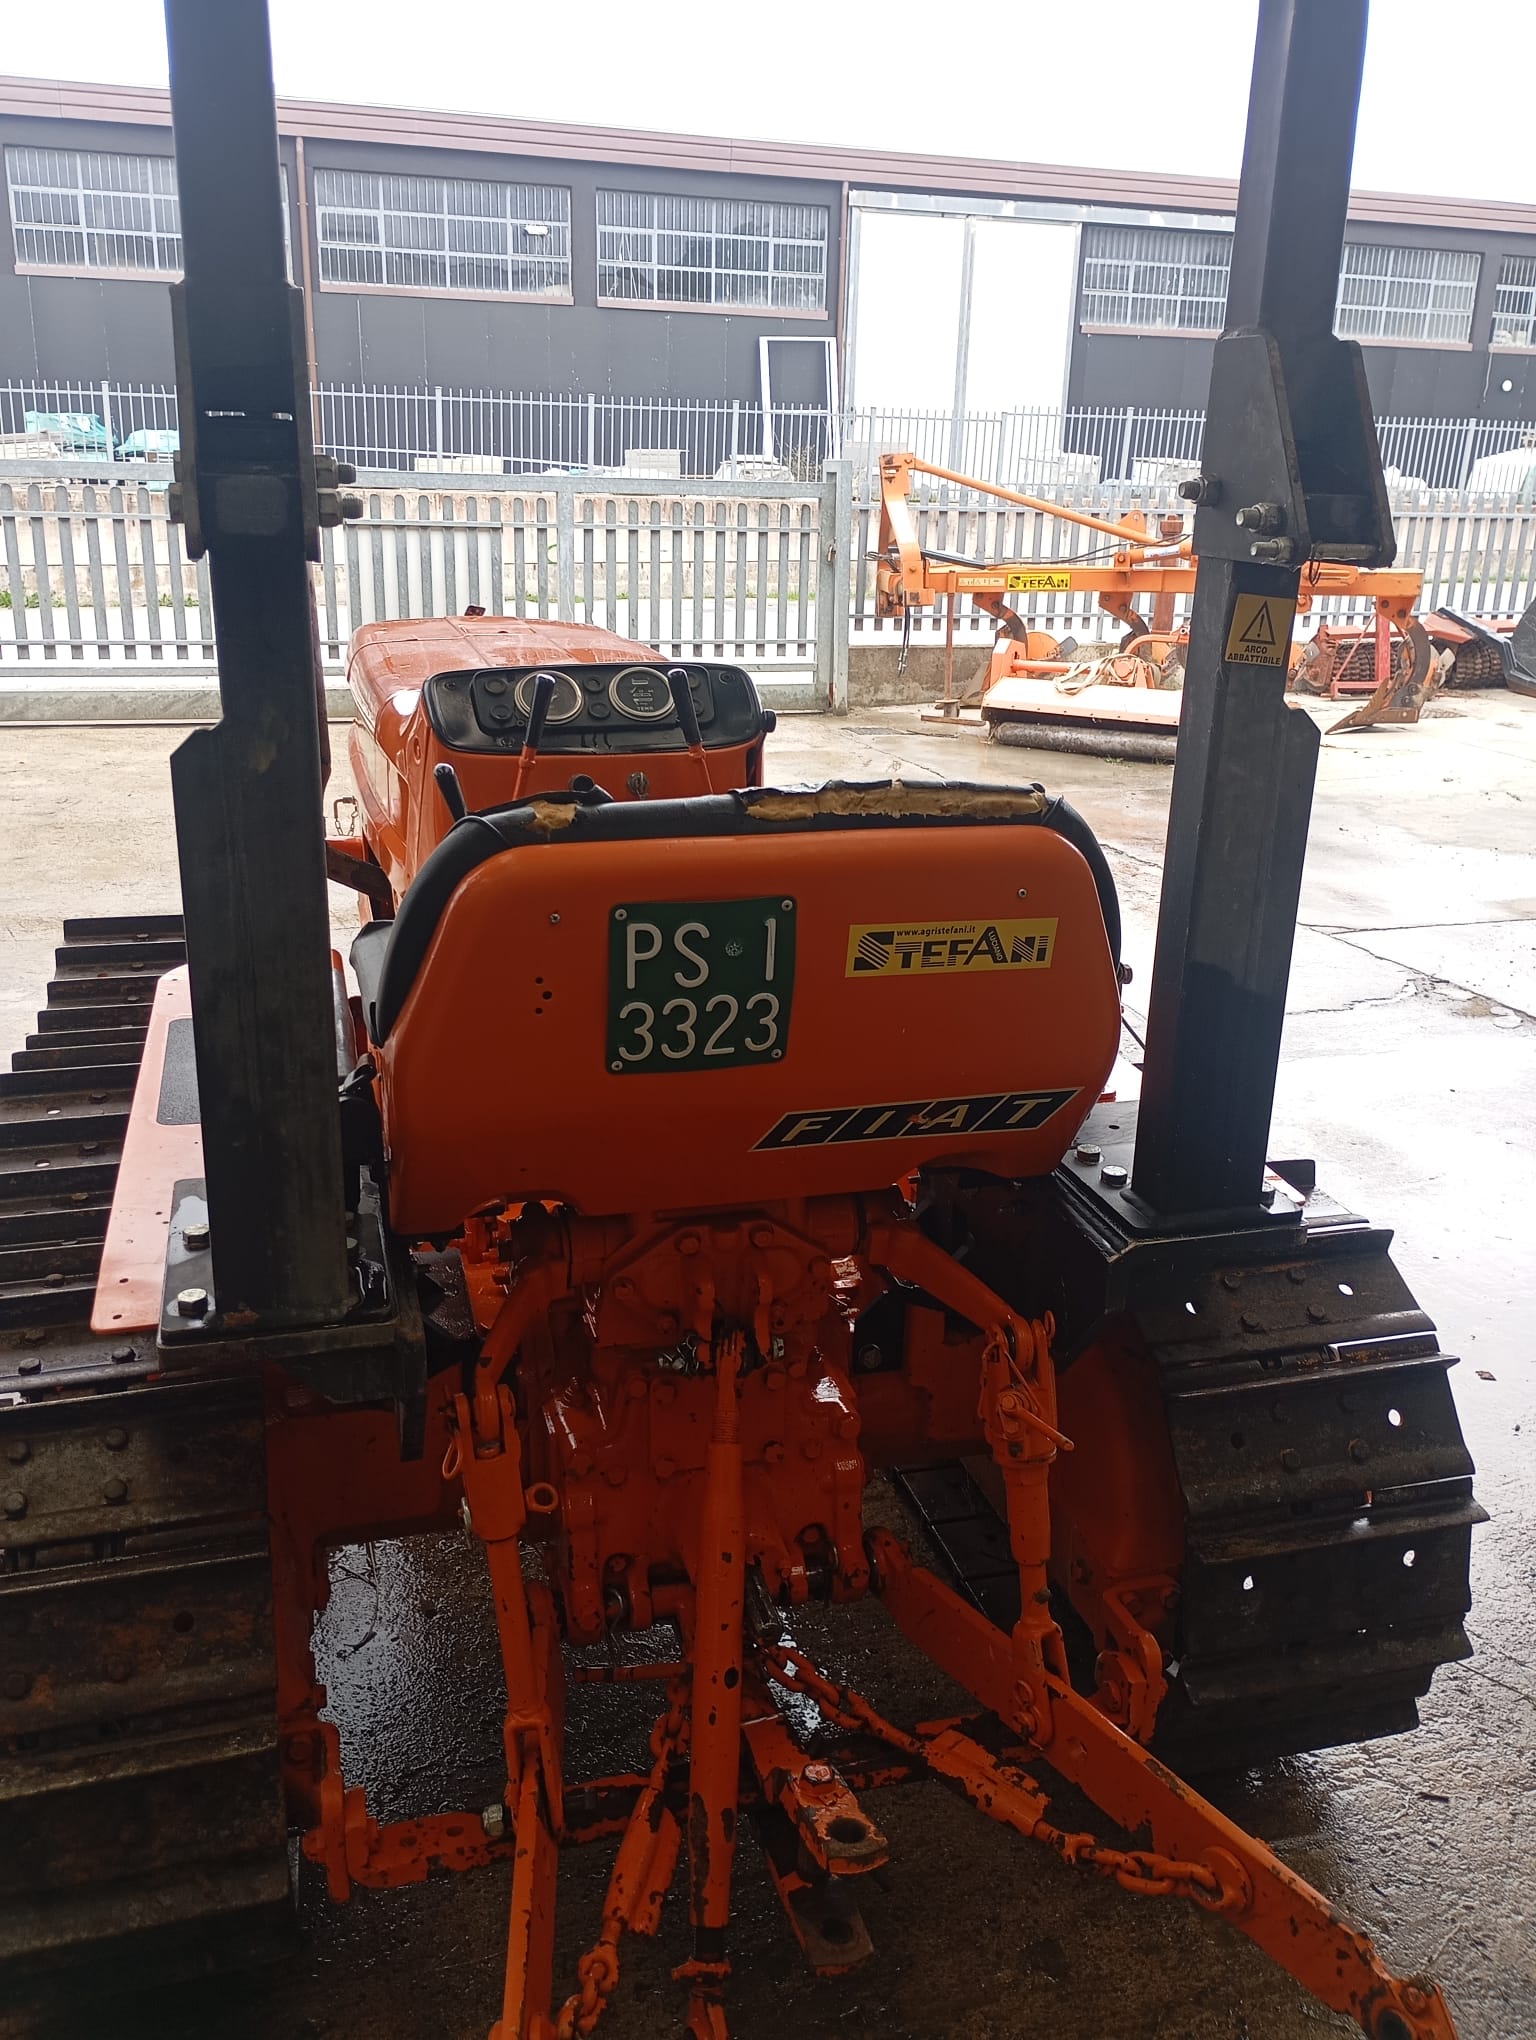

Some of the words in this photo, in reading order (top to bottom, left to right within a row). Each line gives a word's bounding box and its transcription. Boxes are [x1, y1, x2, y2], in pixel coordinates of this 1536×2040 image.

[1227, 653, 1281, 665] ABBATTIBILE
[1244, 645, 1268, 654] ARCO
[896, 925, 976, 937] www.agristefani.it
[626, 922, 710, 989] PS
[618, 992, 780, 1062] 3323
[781, 1098, 1053, 1142] FIAT
